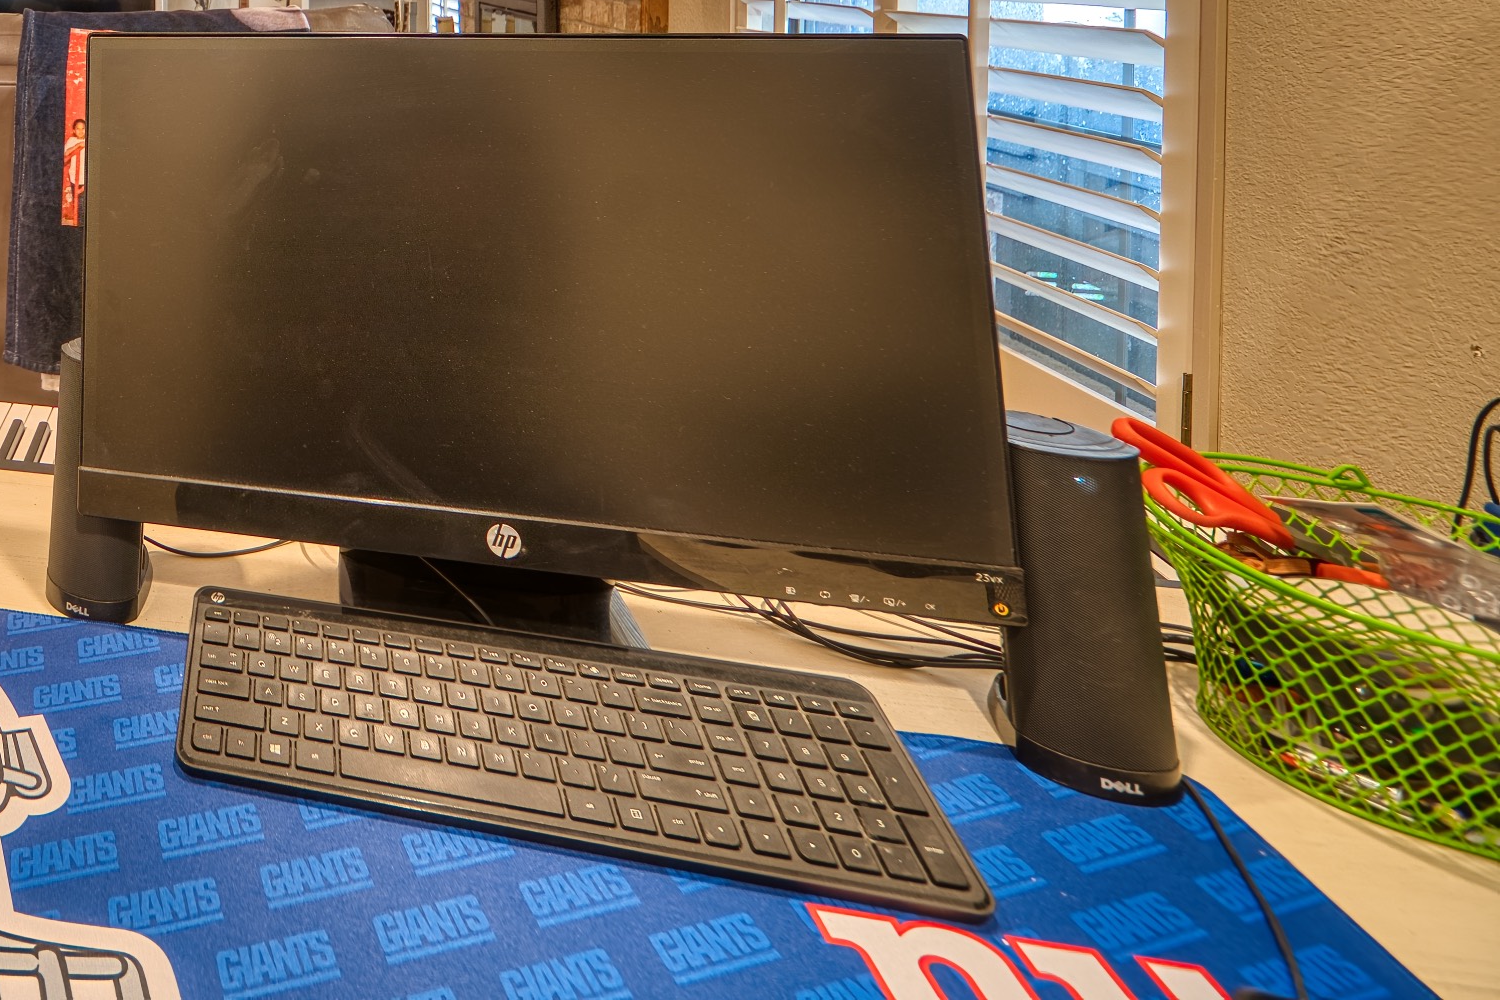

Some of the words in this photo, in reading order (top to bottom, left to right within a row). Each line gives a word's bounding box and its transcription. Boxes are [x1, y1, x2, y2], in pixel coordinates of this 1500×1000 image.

[490, 523, 519, 558] hp
[66, 601, 89, 617] DELL
[211, 592, 225, 603] hp
[77, 631, 160, 659] GIANTS
[33, 673, 122, 709] GIANTS
[112, 708, 180, 742] GIAN
[67, 762, 166, 806] GIANTS
[931, 773, 1012, 816] ANTS
[1100, 777, 1144, 795] DELL
[157, 803, 262, 849] GIANTS
[1041, 814, 1156, 864] GIANTS
[10, 830, 118, 880] GIANTS
[260, 847, 371, 899] GIANTS
[108, 876, 221, 929] GIANTS
[519, 863, 635, 918] GIANTS
[372, 894, 490, 954] GIANTS
[650, 911, 773, 974] GIANTS
[1070, 891, 1195, 950] GIANTS
[216, 929, 337, 992] GIANTS
[500, 948, 626, 1000] GIANTS
